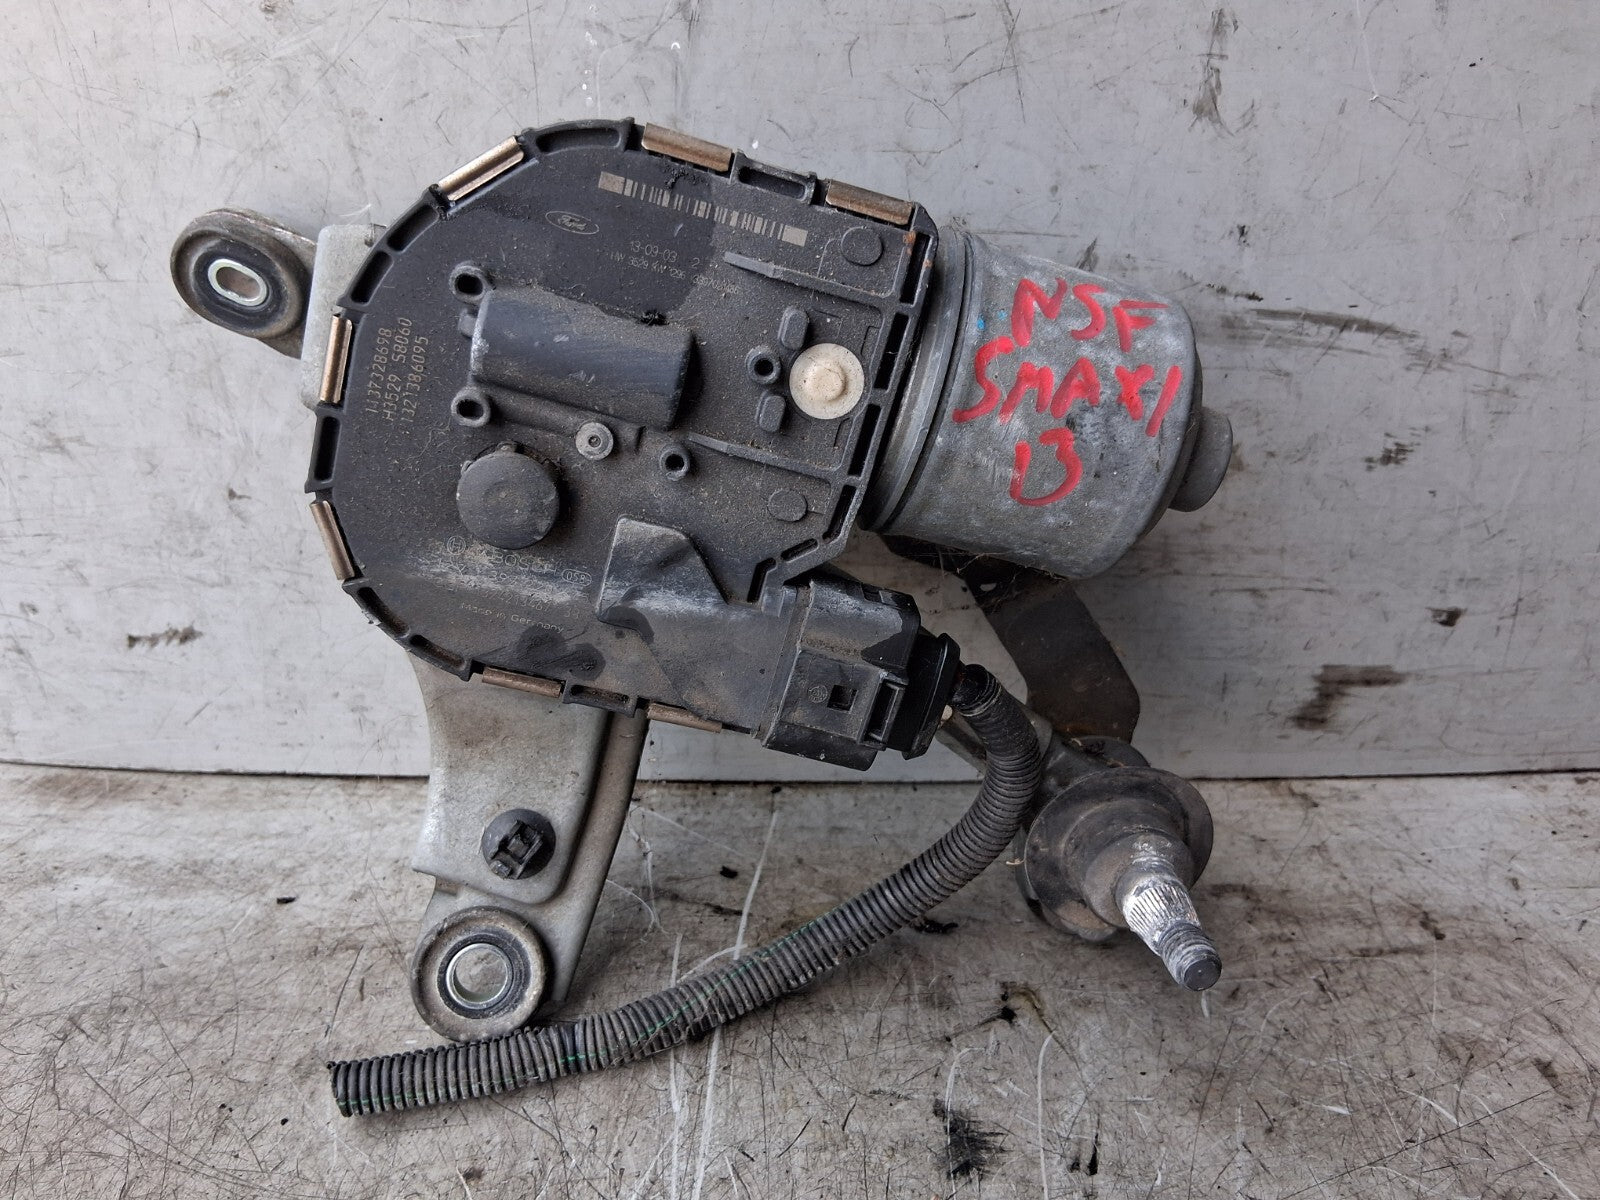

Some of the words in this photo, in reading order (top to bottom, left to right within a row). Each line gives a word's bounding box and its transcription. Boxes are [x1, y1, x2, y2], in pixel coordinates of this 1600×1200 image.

[1010, 278, 1168, 353] NSF
[365, 327, 393, 414] 1137328698
[400, 335, 429, 423] 1321386095
